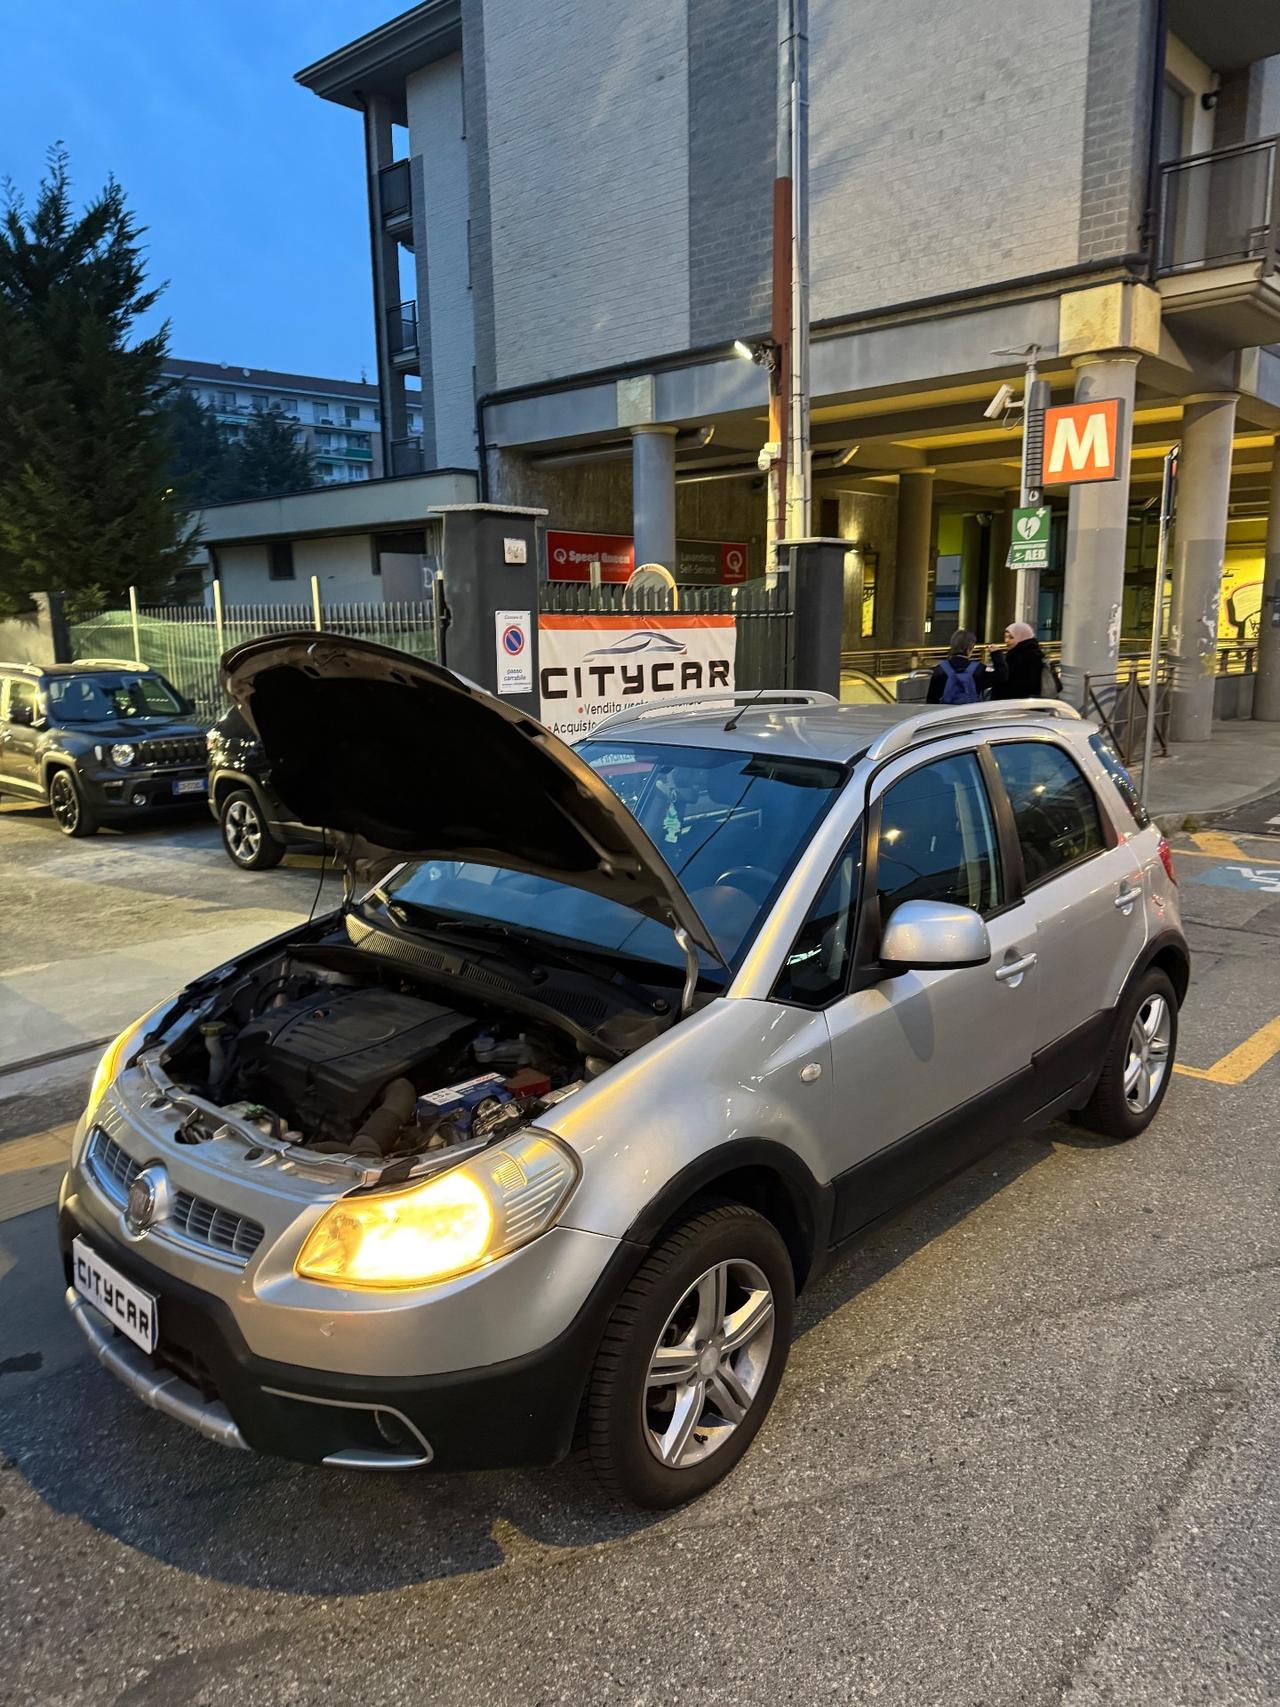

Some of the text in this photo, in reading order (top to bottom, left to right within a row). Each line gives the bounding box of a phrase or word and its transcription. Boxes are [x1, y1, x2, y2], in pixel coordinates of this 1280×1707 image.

[1048, 413, 1110, 473] M
[568, 550, 599, 564] Speed
[1024, 549, 1046, 561] AED
[540, 660, 730, 700] CITYCAR
[584, 700, 621, 715] Vendita
[77, 1256, 149, 1340] CITYCAR
